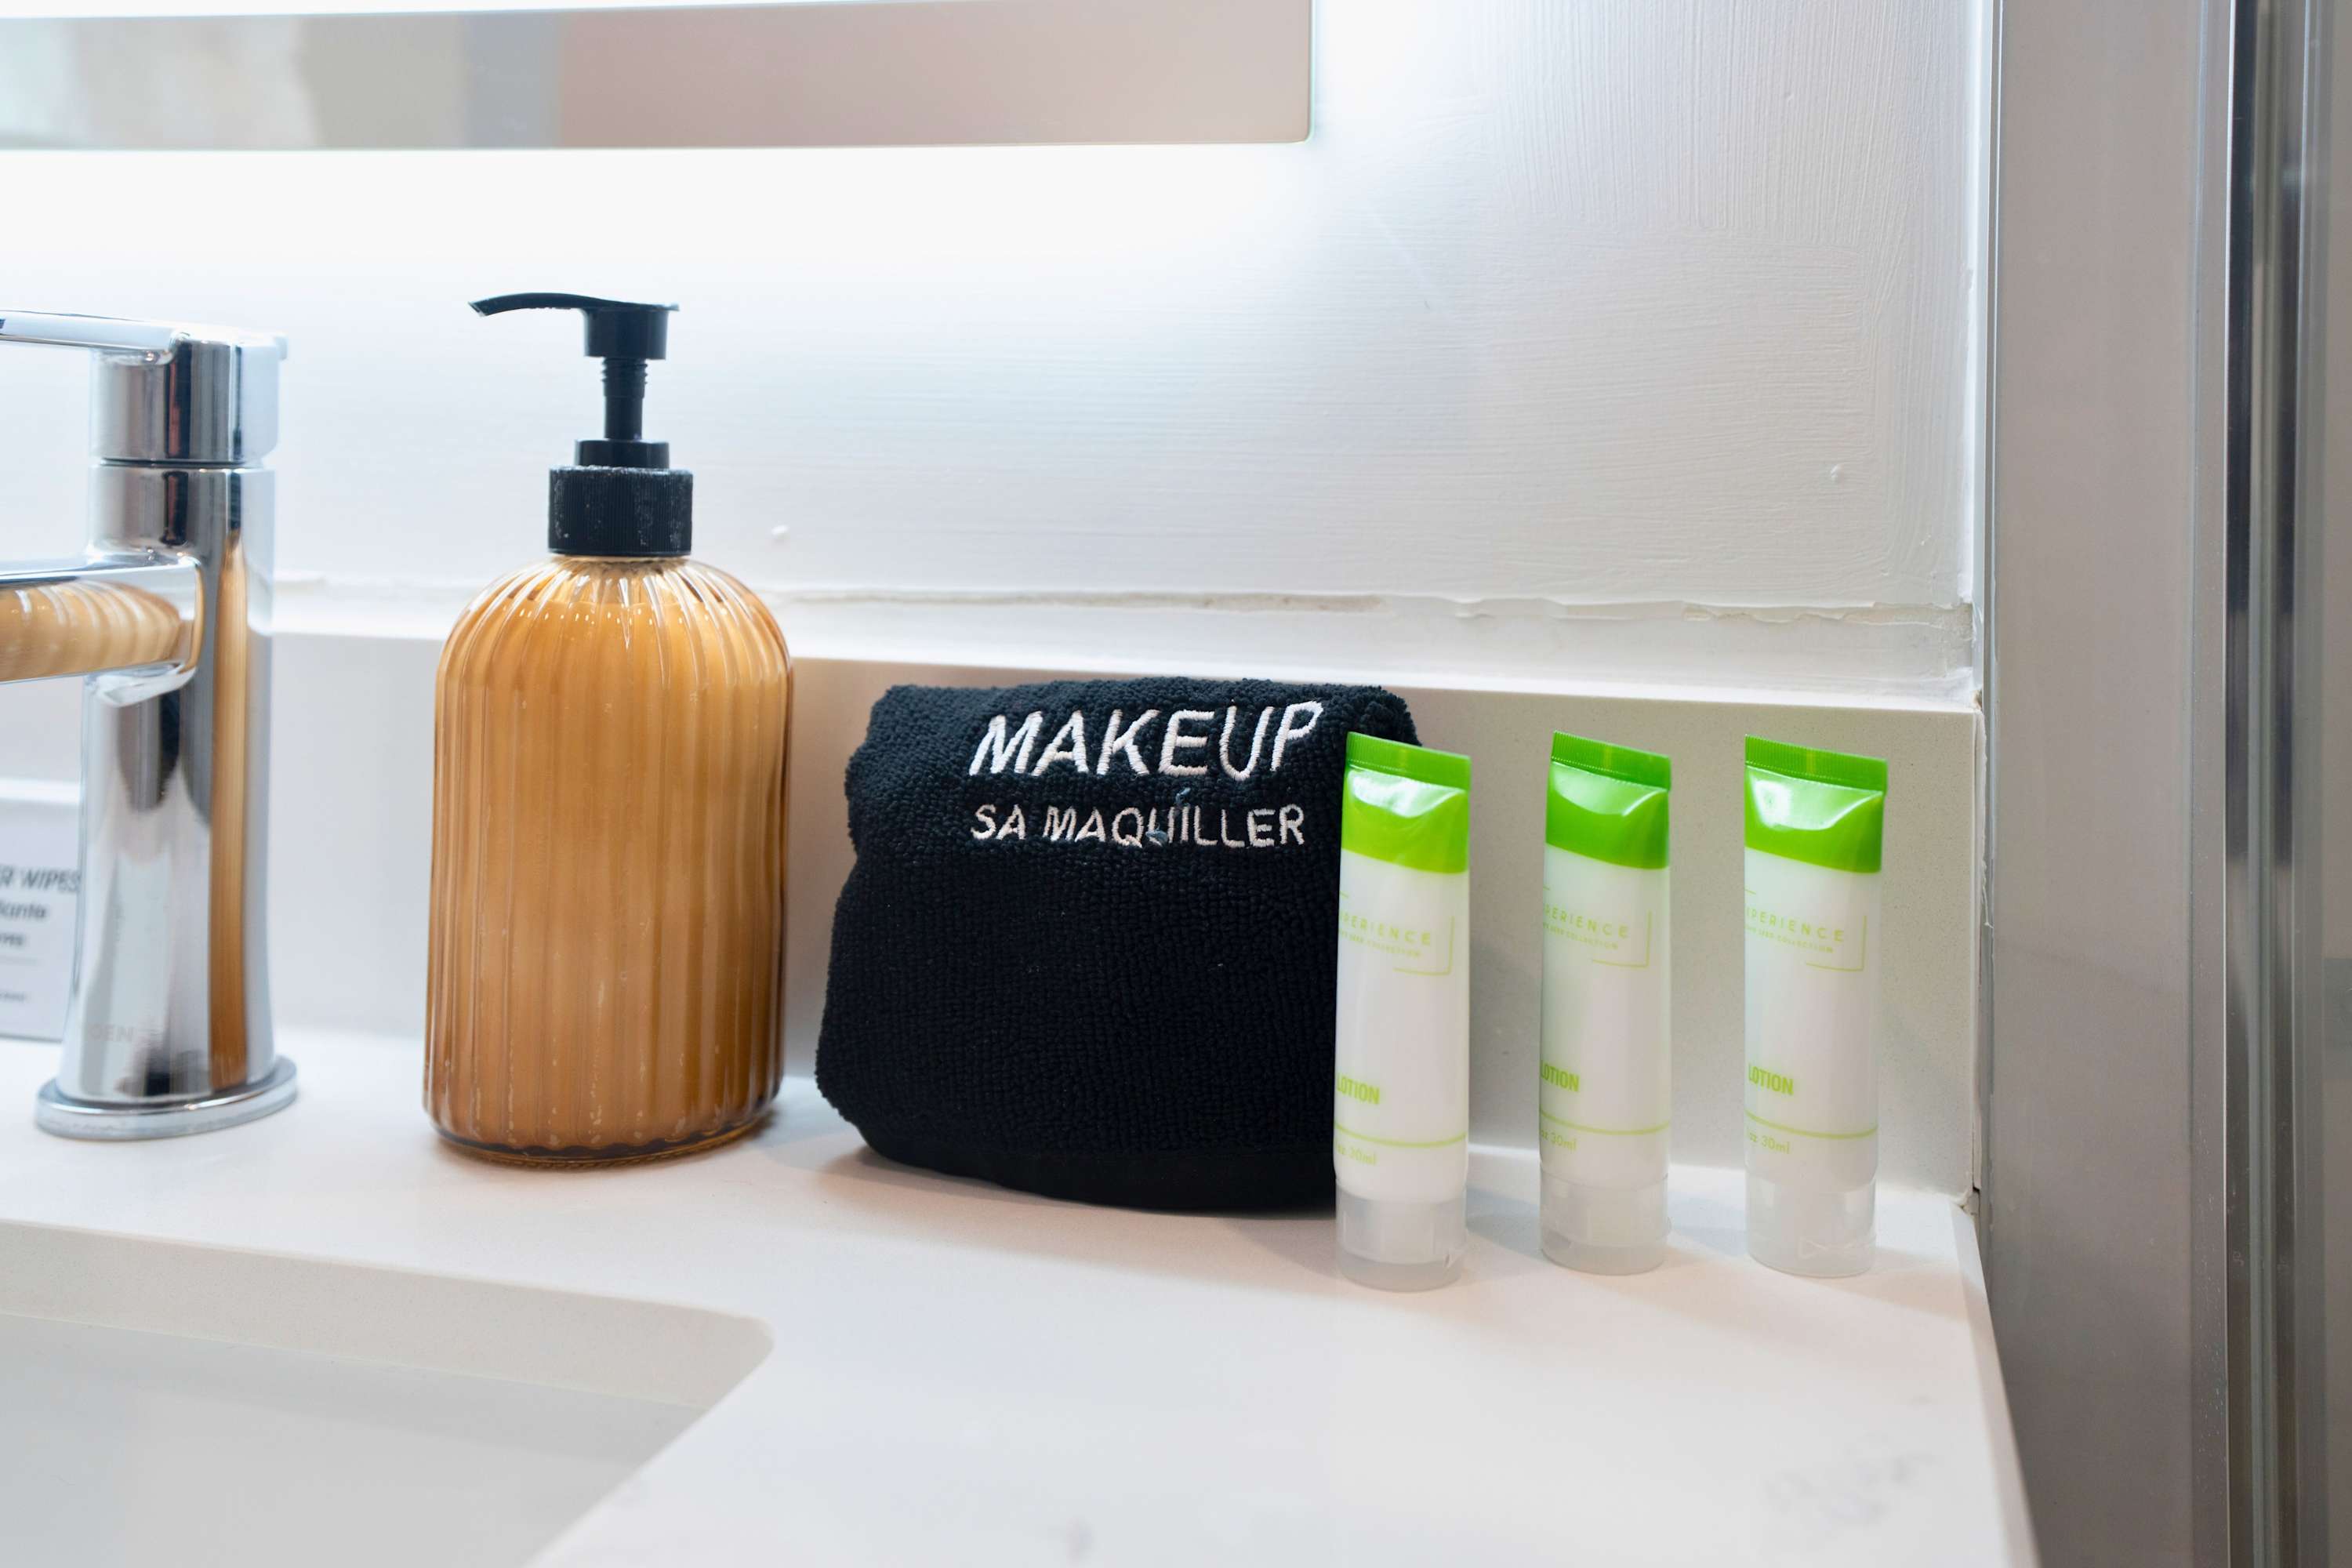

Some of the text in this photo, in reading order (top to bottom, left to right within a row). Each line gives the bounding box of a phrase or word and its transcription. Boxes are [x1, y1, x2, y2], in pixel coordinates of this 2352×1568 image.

[969, 700, 1323, 782] MAKEUP
[971, 803, 1305, 848] SA MAQUILLER
[1338, 1073, 1380, 1105] LOTION
[1748, 1063, 1794, 1094] LOTION
[1762, 1135, 1790, 1154] 30ml
